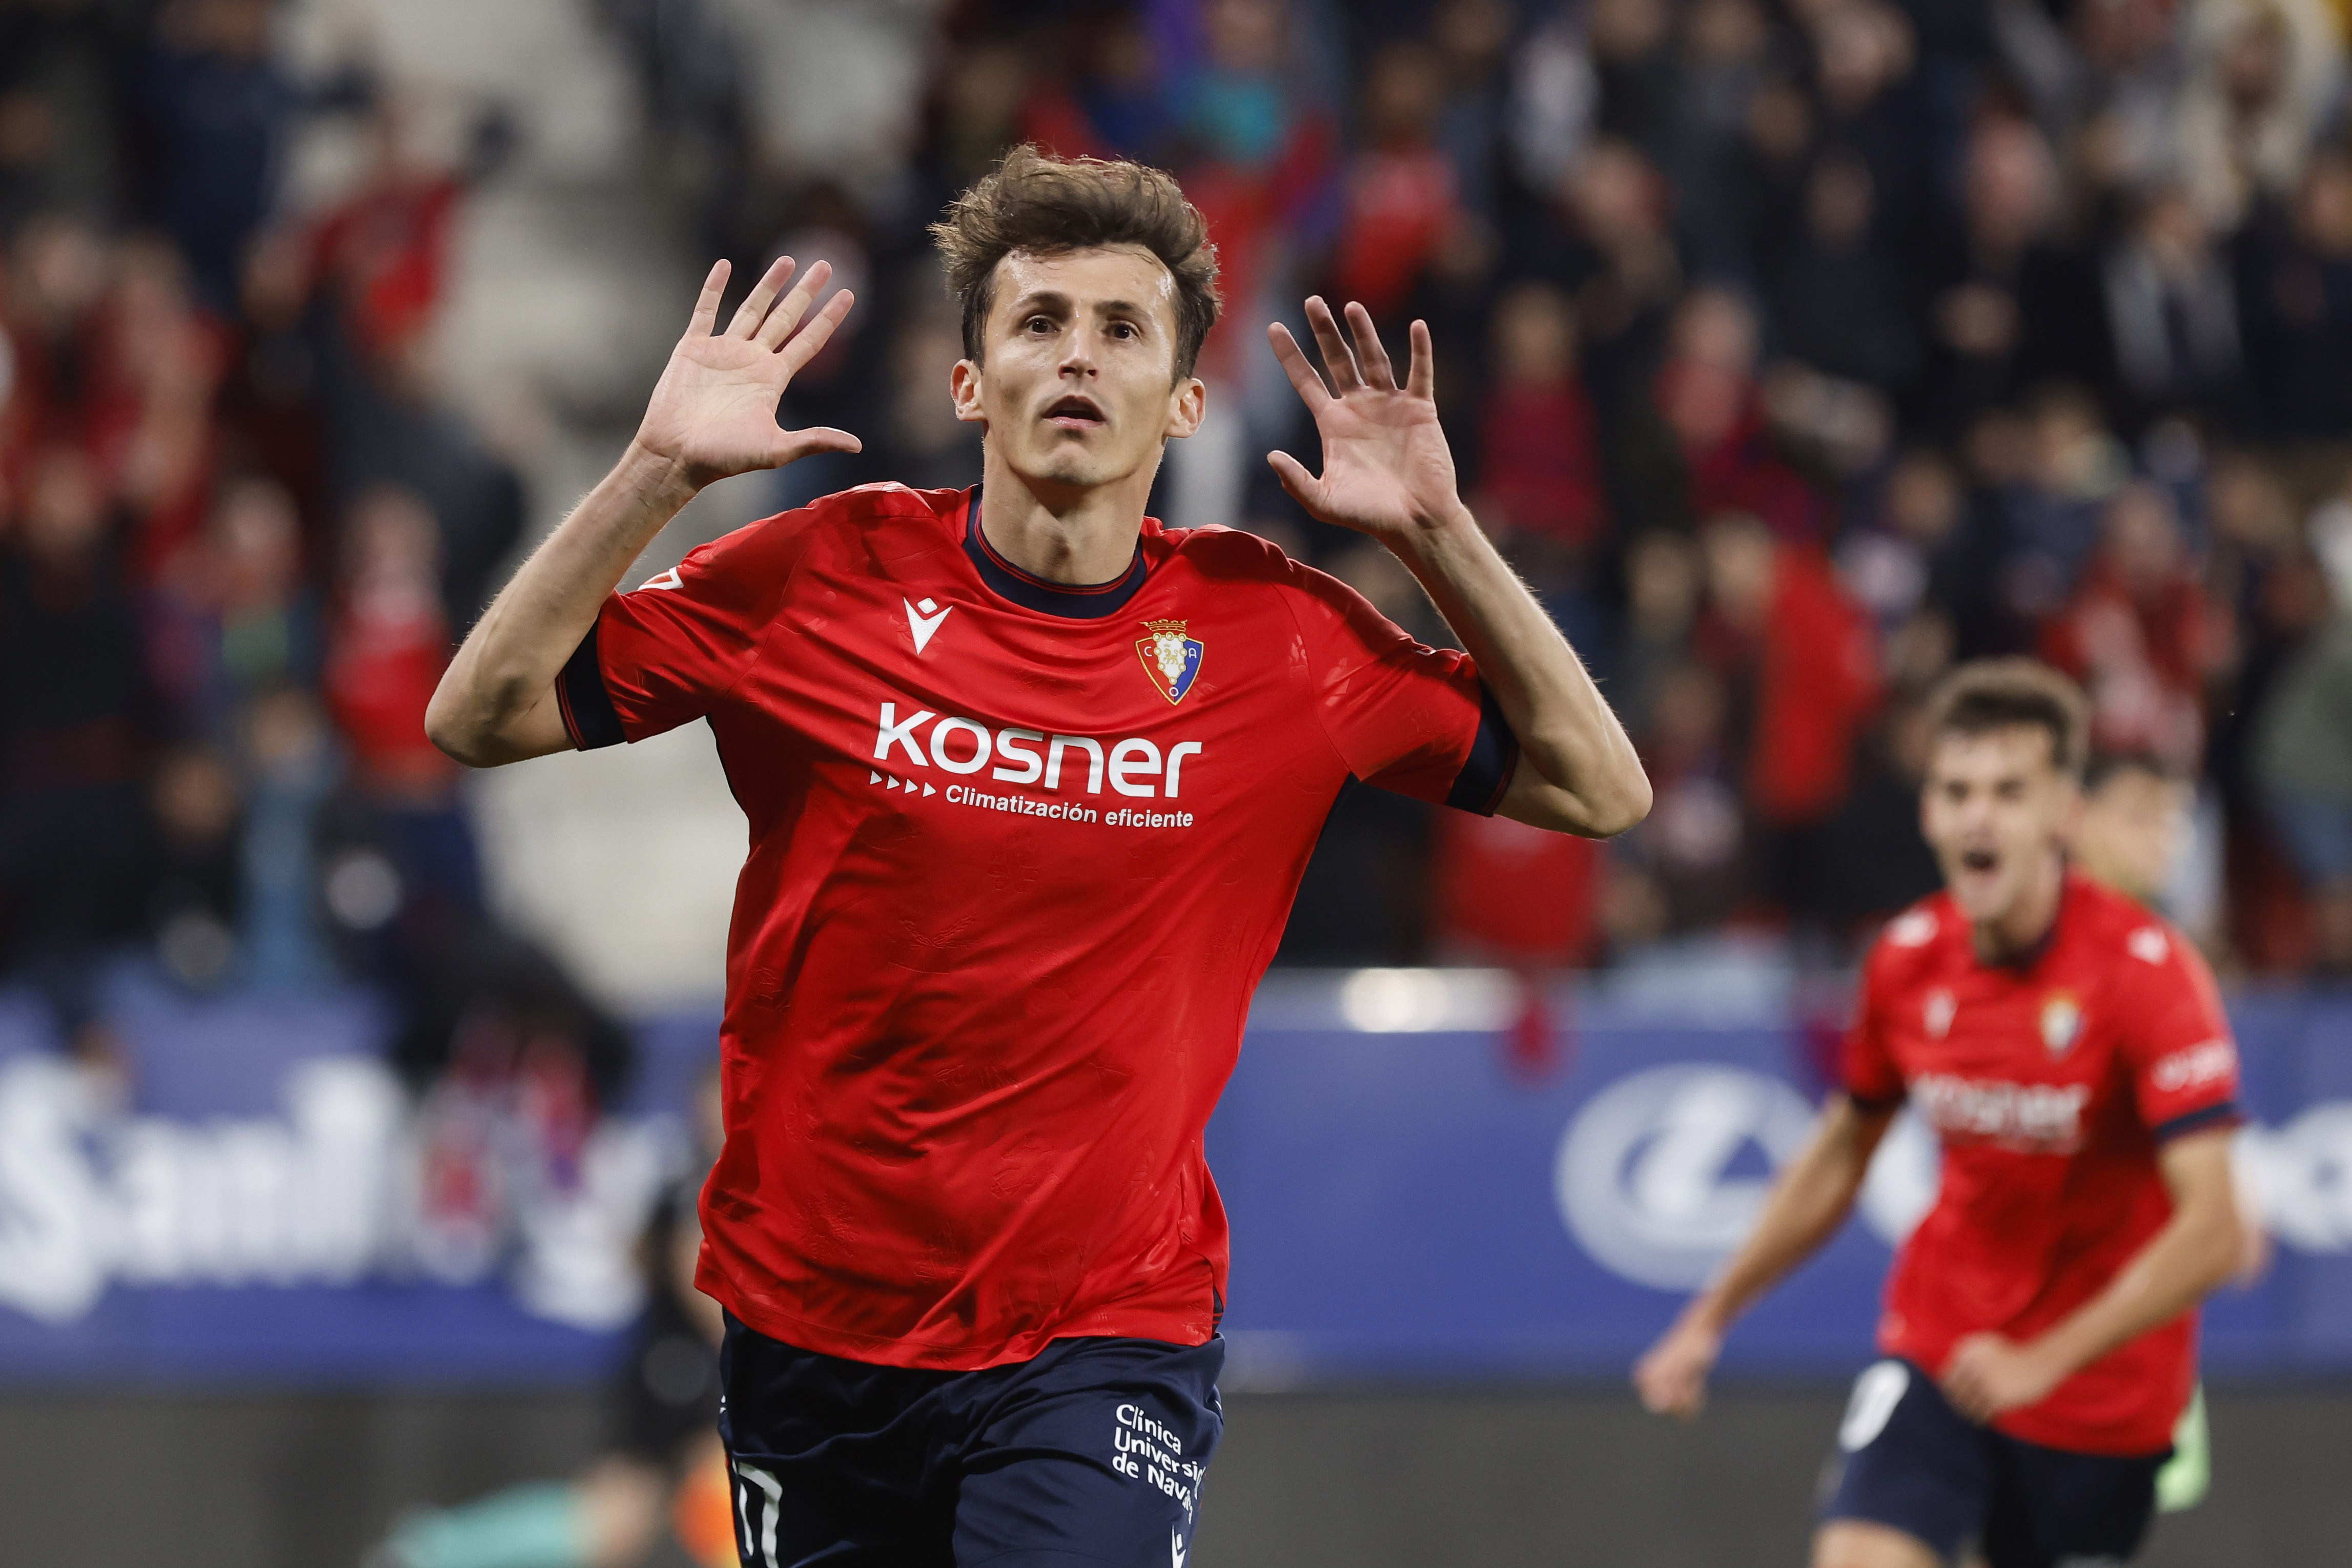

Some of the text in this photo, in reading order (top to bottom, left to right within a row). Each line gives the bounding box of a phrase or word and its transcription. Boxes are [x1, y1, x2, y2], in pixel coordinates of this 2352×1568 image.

[873, 702, 1202, 798] Kosner
[946, 783, 1194, 828] Climatización eficiente
[1115, 1404, 1181, 1456] Clínica
[1112, 1452, 1139, 1479] de
